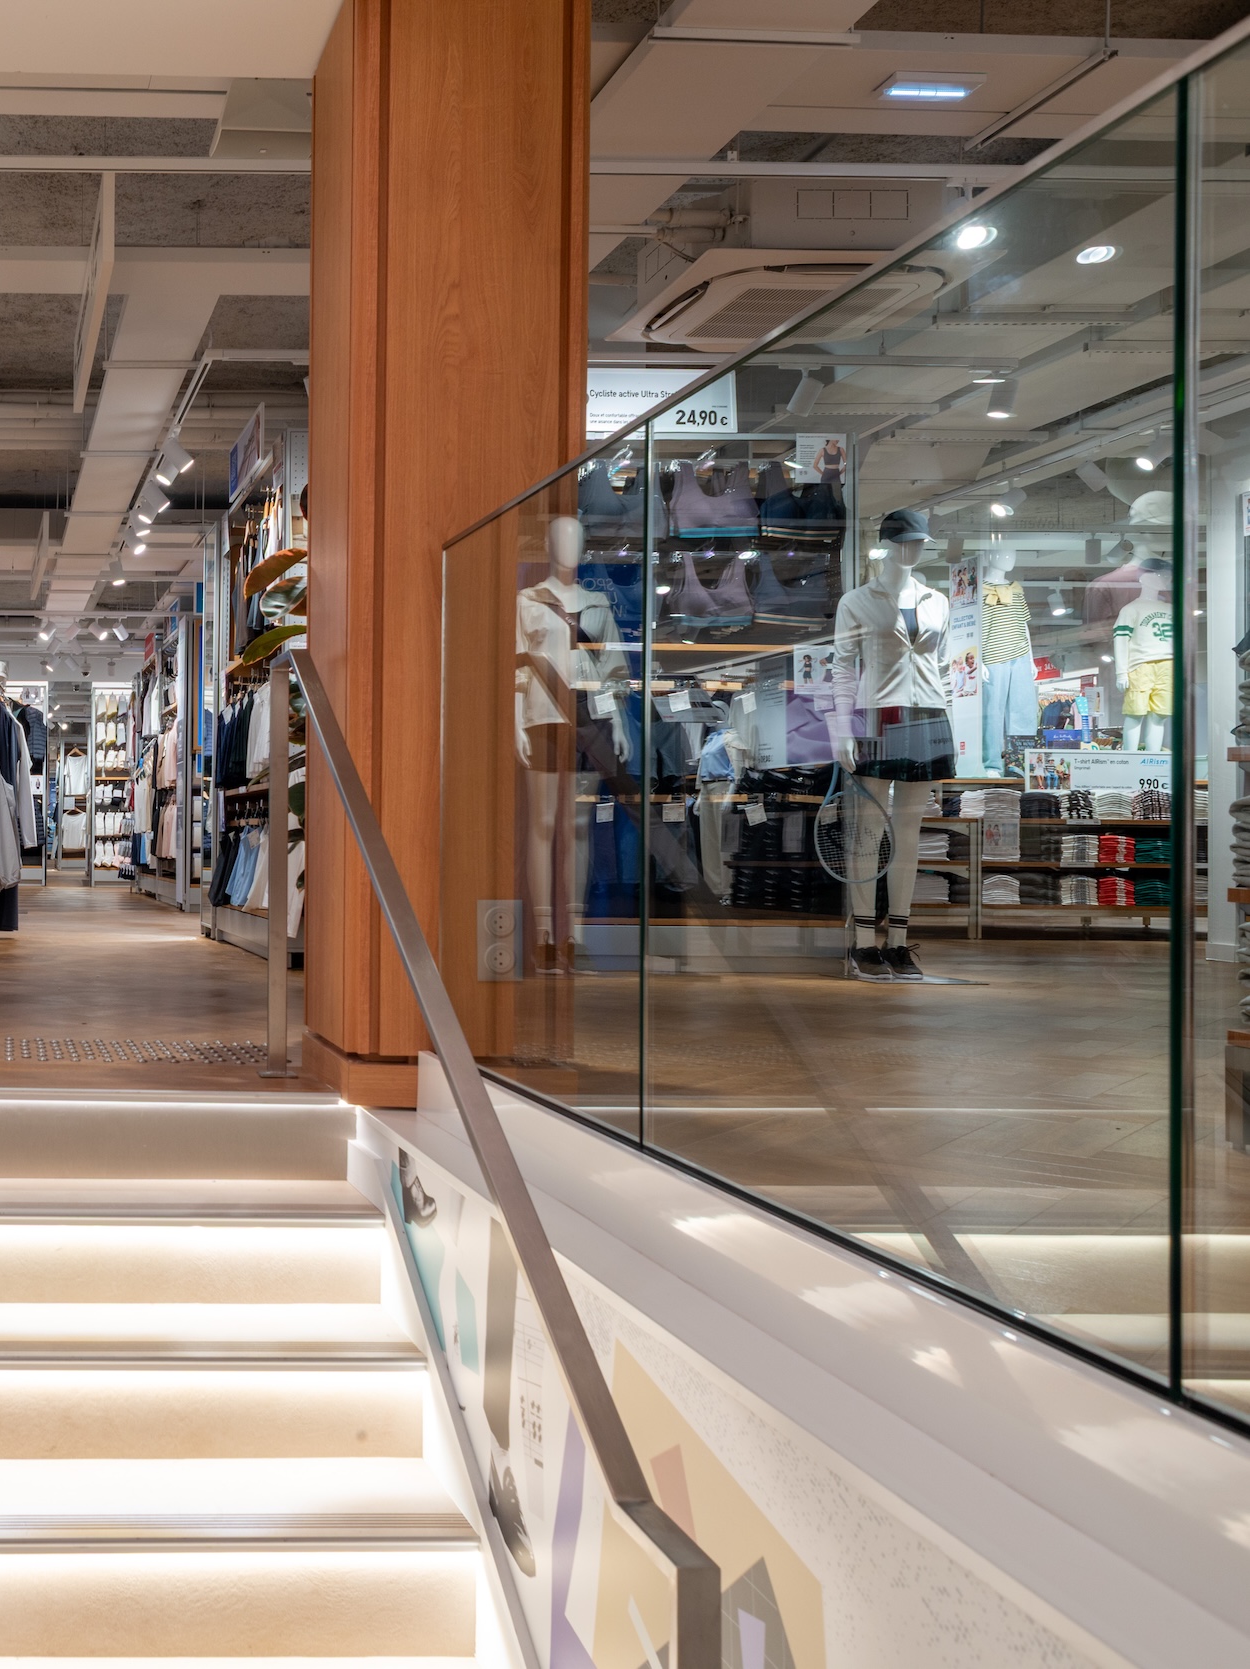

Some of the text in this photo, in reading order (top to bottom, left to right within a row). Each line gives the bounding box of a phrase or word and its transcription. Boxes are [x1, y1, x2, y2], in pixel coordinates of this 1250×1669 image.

[589, 390, 617, 398] Cycliste
[618, 390, 639, 398] active
[640, 390, 658, 398] Ultra
[675, 410, 728, 427] 24,90 €
[954, 614, 973, 623] COLLECTION
[1139, 779, 1159, 790] 9,90
